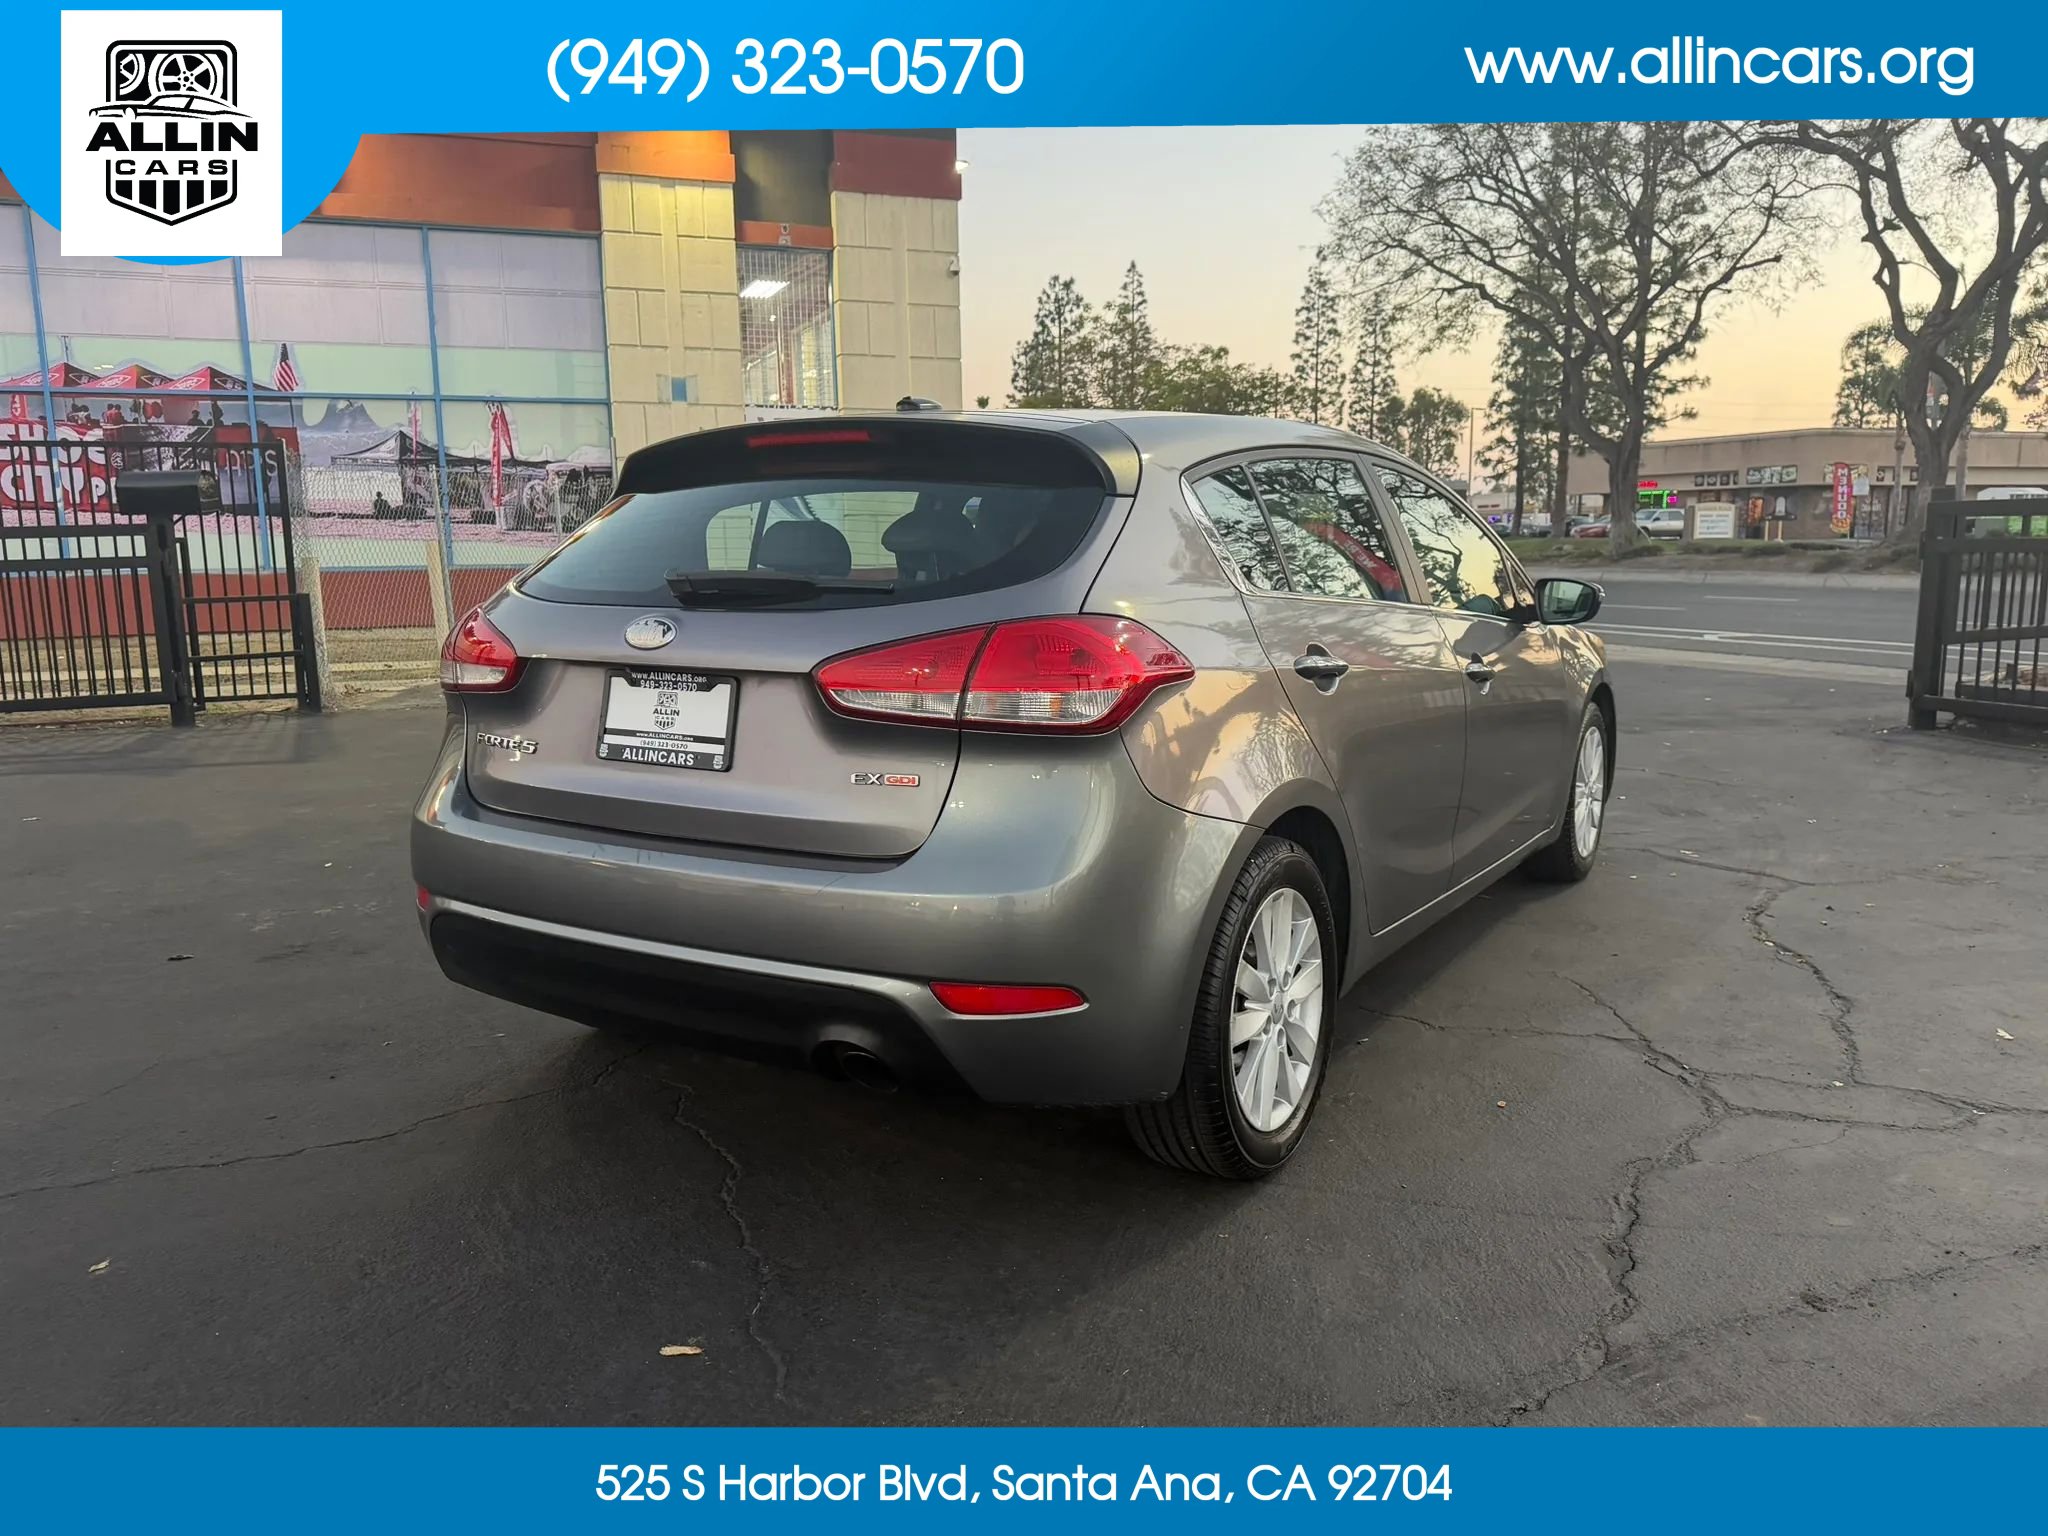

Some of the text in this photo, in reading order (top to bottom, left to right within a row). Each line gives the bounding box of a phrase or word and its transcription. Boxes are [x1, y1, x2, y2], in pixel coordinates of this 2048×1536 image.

[640, 680, 697, 692] 949-323-0570
[653, 708, 680, 717] ALLIN
[622, 747, 694, 766] ALLINCARS
[850, 772, 916, 785] EX GDI
